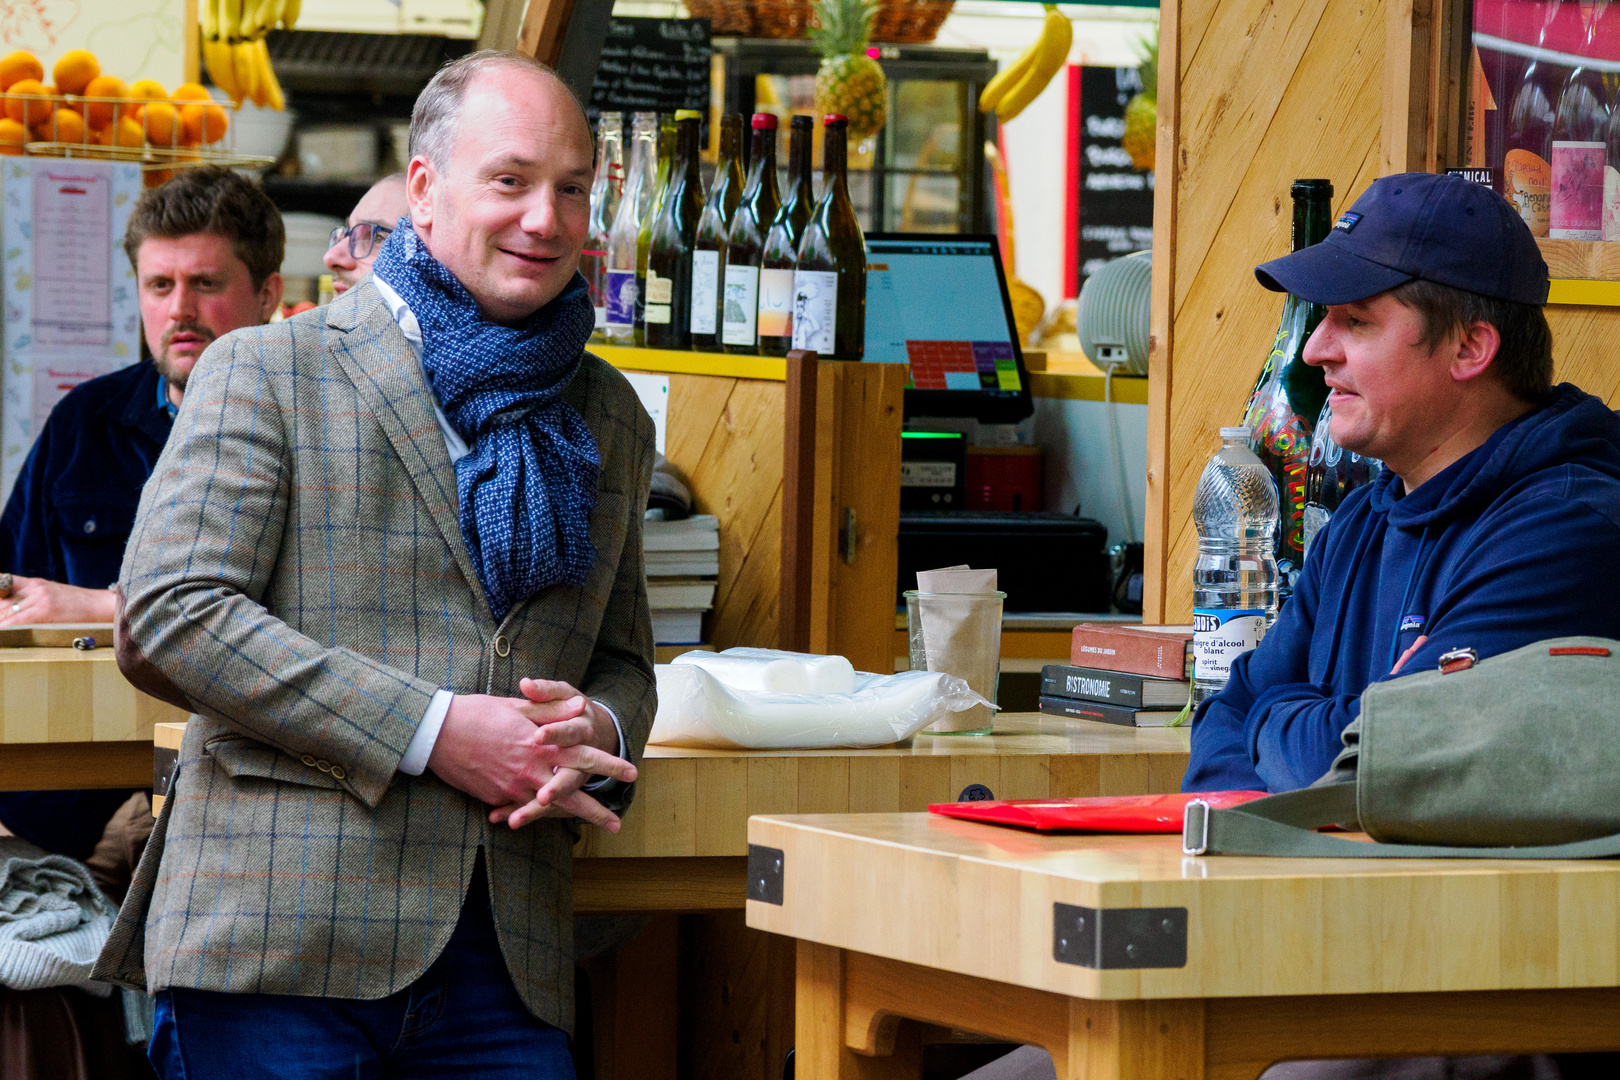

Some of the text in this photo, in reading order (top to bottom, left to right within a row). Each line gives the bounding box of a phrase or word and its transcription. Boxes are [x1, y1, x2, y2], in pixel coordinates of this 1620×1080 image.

[1448, 170, 1491, 183] MICAL
[1210, 639, 1245, 648] d'alcool
[1103, 648, 1116, 656] JARDIN
[1203, 647, 1225, 655] blanc
